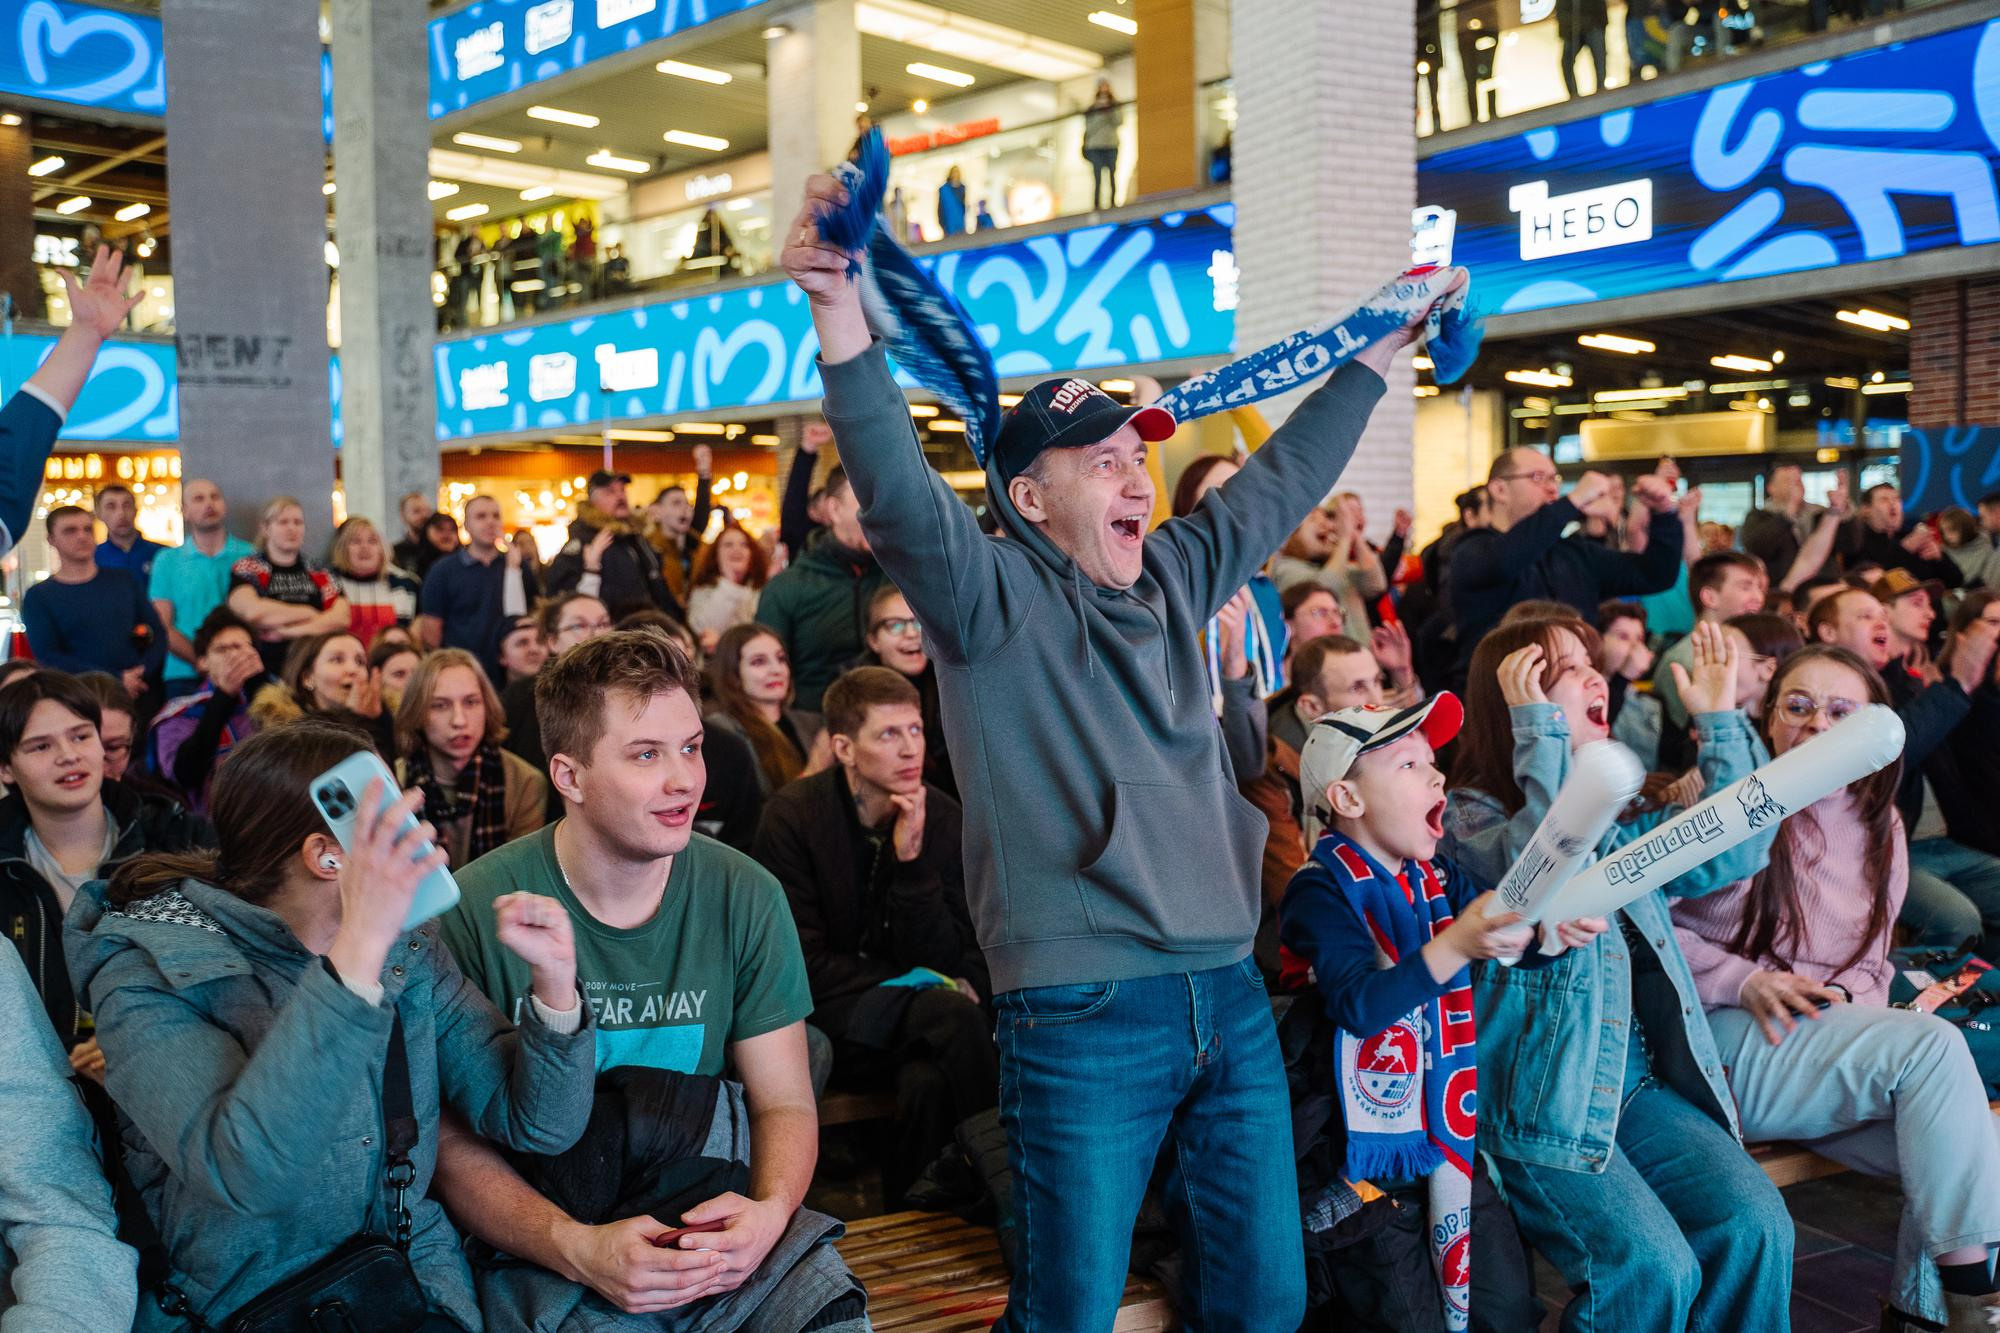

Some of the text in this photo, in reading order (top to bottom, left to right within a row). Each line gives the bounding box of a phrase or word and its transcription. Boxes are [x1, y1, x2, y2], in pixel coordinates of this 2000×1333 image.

[1533, 197, 1639, 244] НЕБО
[586, 981, 637, 992] BODY MOVE
[638, 989, 707, 1023] AWAY
